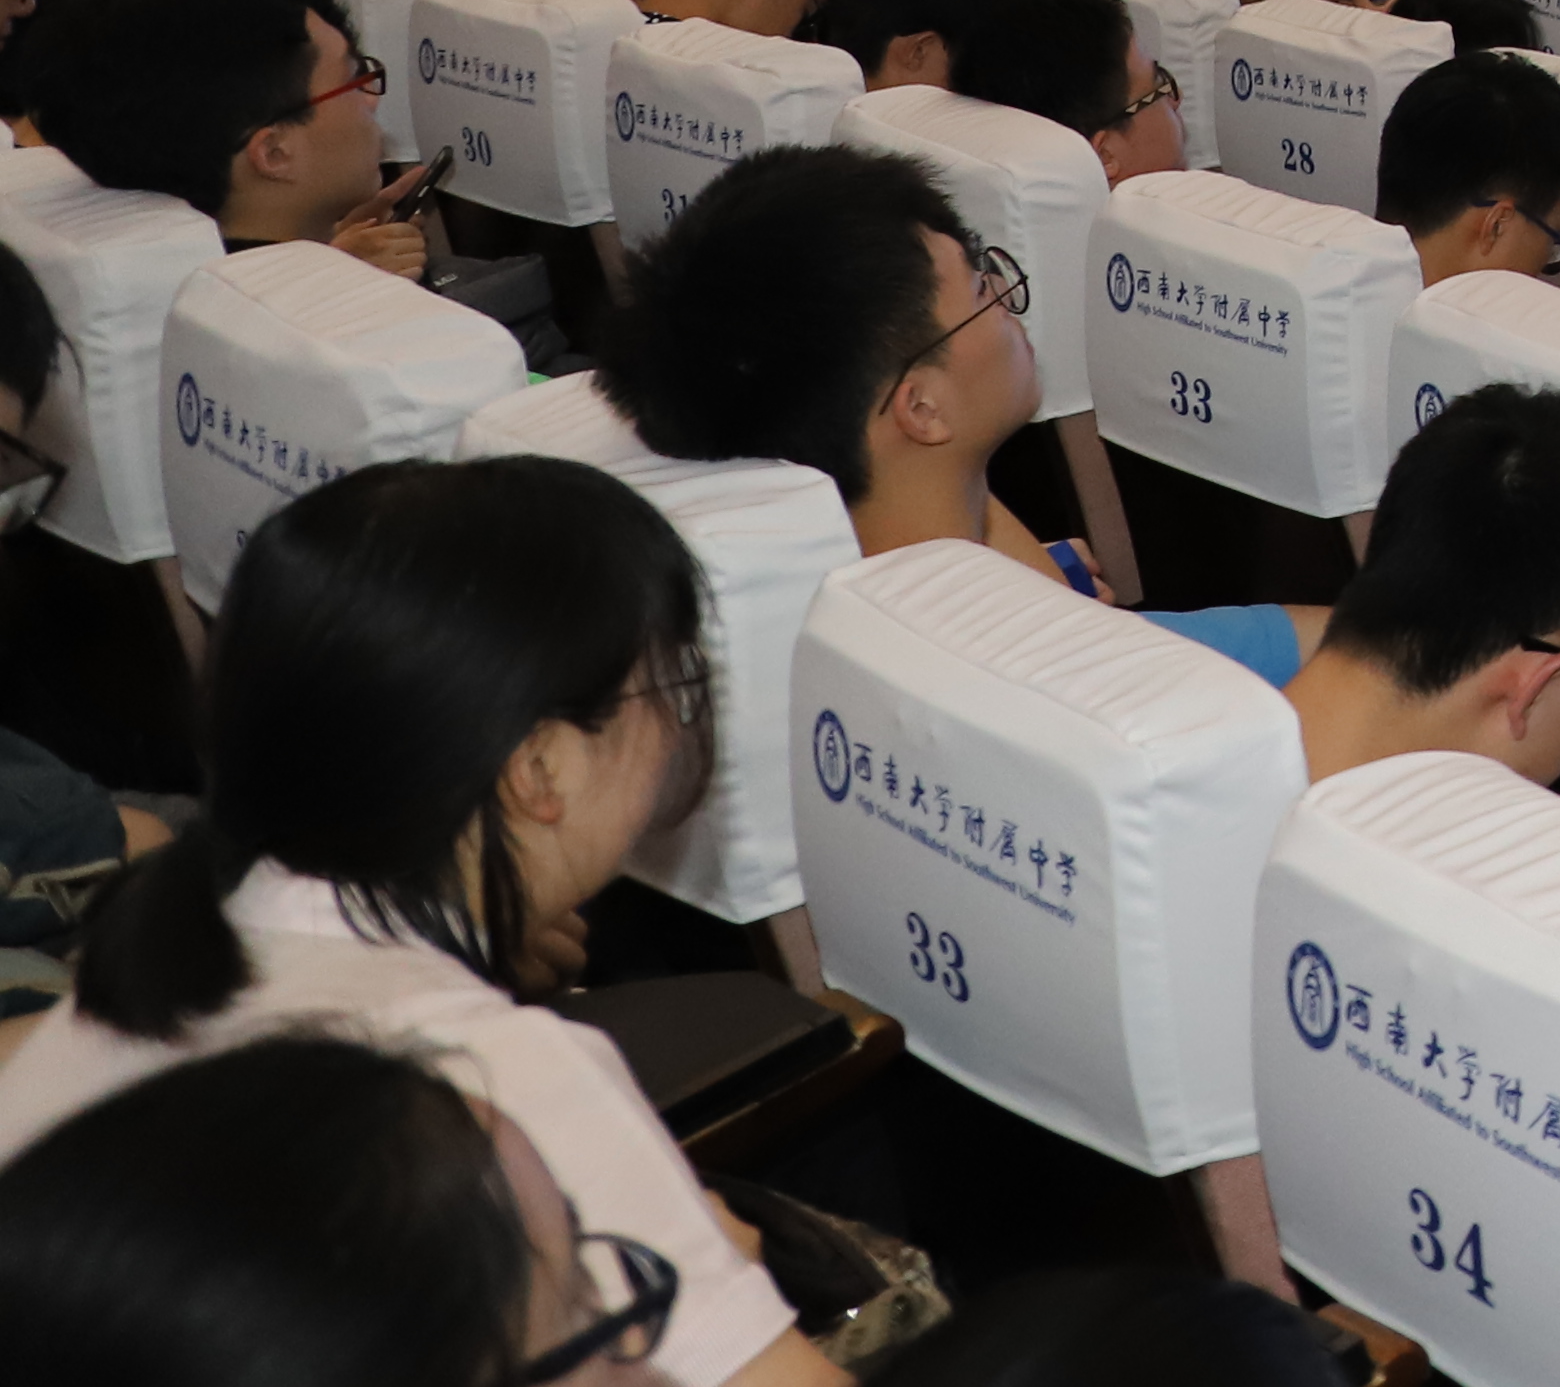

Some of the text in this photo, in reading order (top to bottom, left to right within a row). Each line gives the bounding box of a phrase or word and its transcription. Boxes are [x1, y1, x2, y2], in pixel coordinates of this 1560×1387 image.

[1281, 139, 1315, 175] 28
[1137, 269, 1290, 339] 西南大学附属中学
[1170, 370, 1213, 424] 33
[854, 742, 1078, 897] 西南大学附属中学
[906, 910, 970, 1004] 33
[1408, 1187, 1495, 1309] 34
